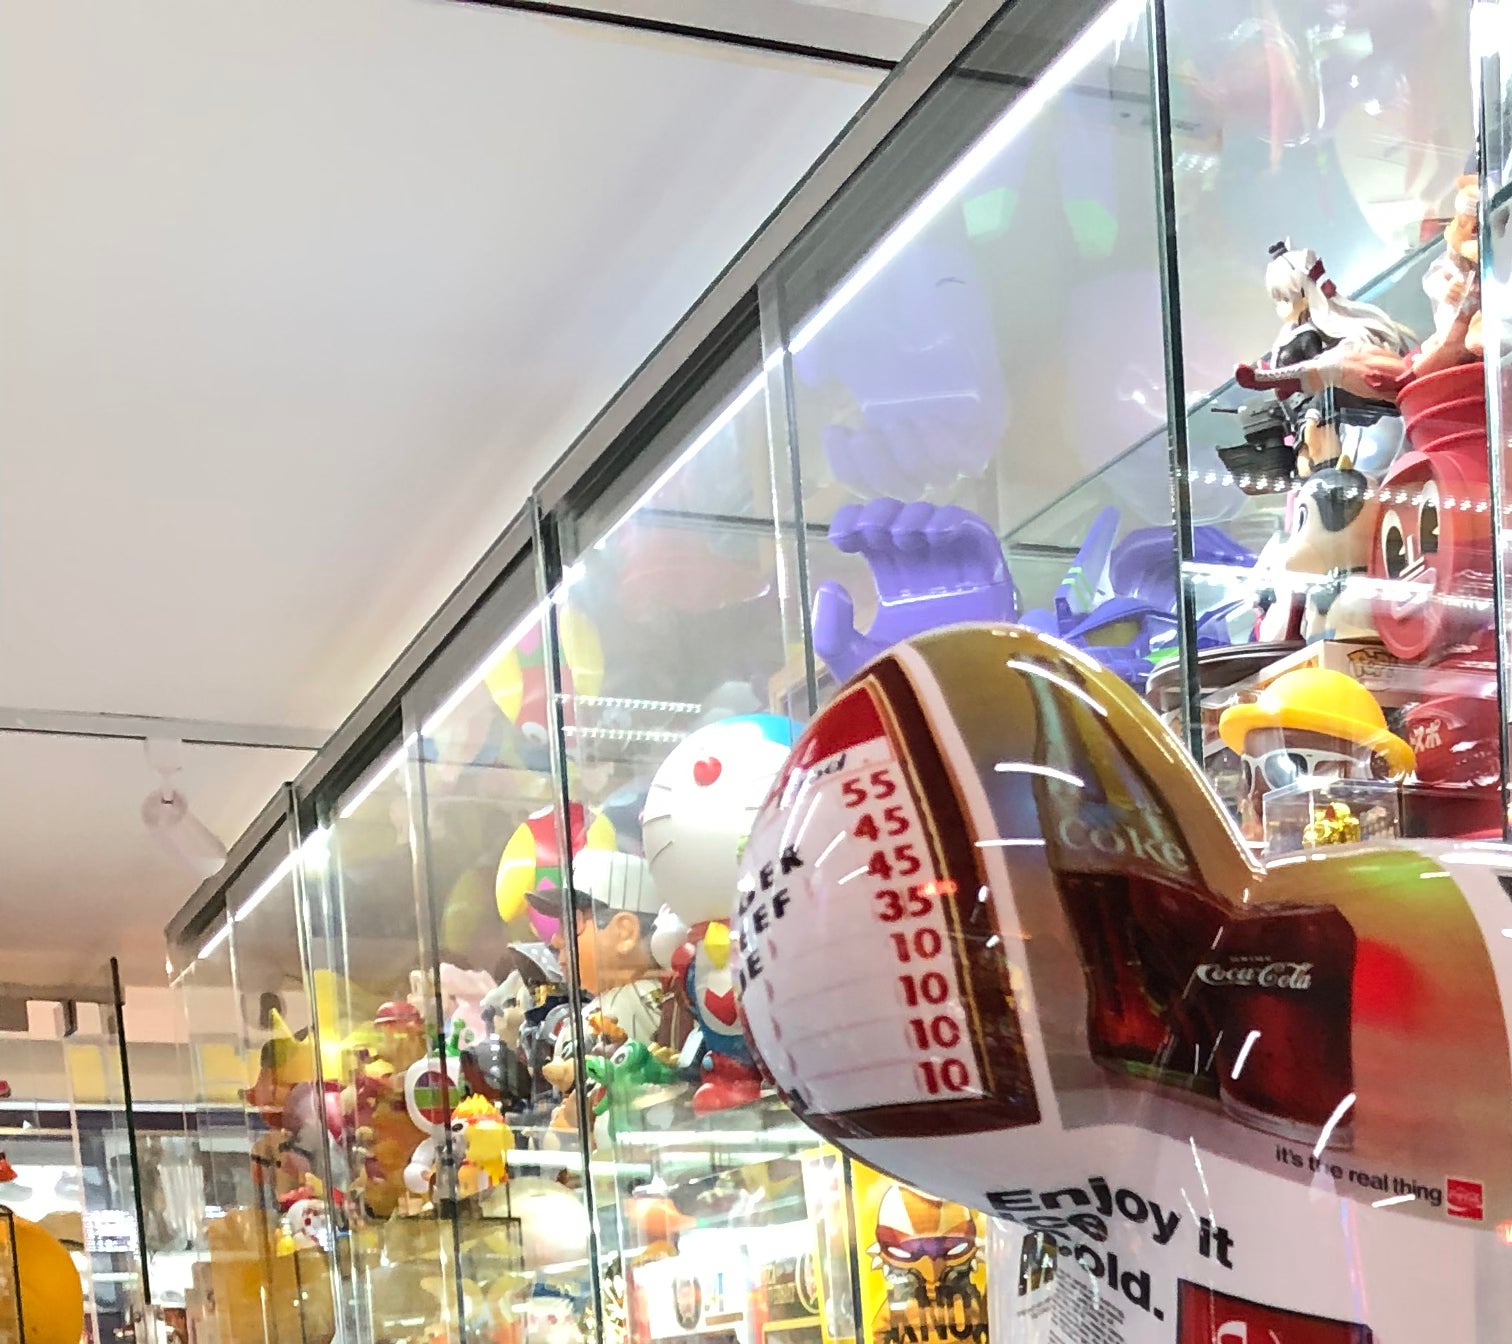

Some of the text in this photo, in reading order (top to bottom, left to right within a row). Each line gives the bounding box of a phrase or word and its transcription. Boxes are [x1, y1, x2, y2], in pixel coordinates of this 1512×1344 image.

[841, 770, 896, 809] 55
[853, 806, 910, 842] 45
[1058, 819, 1188, 870] Coke
[867, 847, 921, 882] 45
[873, 887, 932, 924] 35
[891, 928, 942, 963] 10
[898, 972, 949, 1006] 10
[1197, 961, 1314, 991] Coca-Cola
[909, 1015, 960, 1050] 10
[918, 1059, 971, 1095] 10
[1275, 1144, 1303, 1169] it's
[1348, 1166, 1389, 1193] real
[1392, 1177, 1443, 1207] thing
[986, 1176, 1236, 1271] Enjoy it
